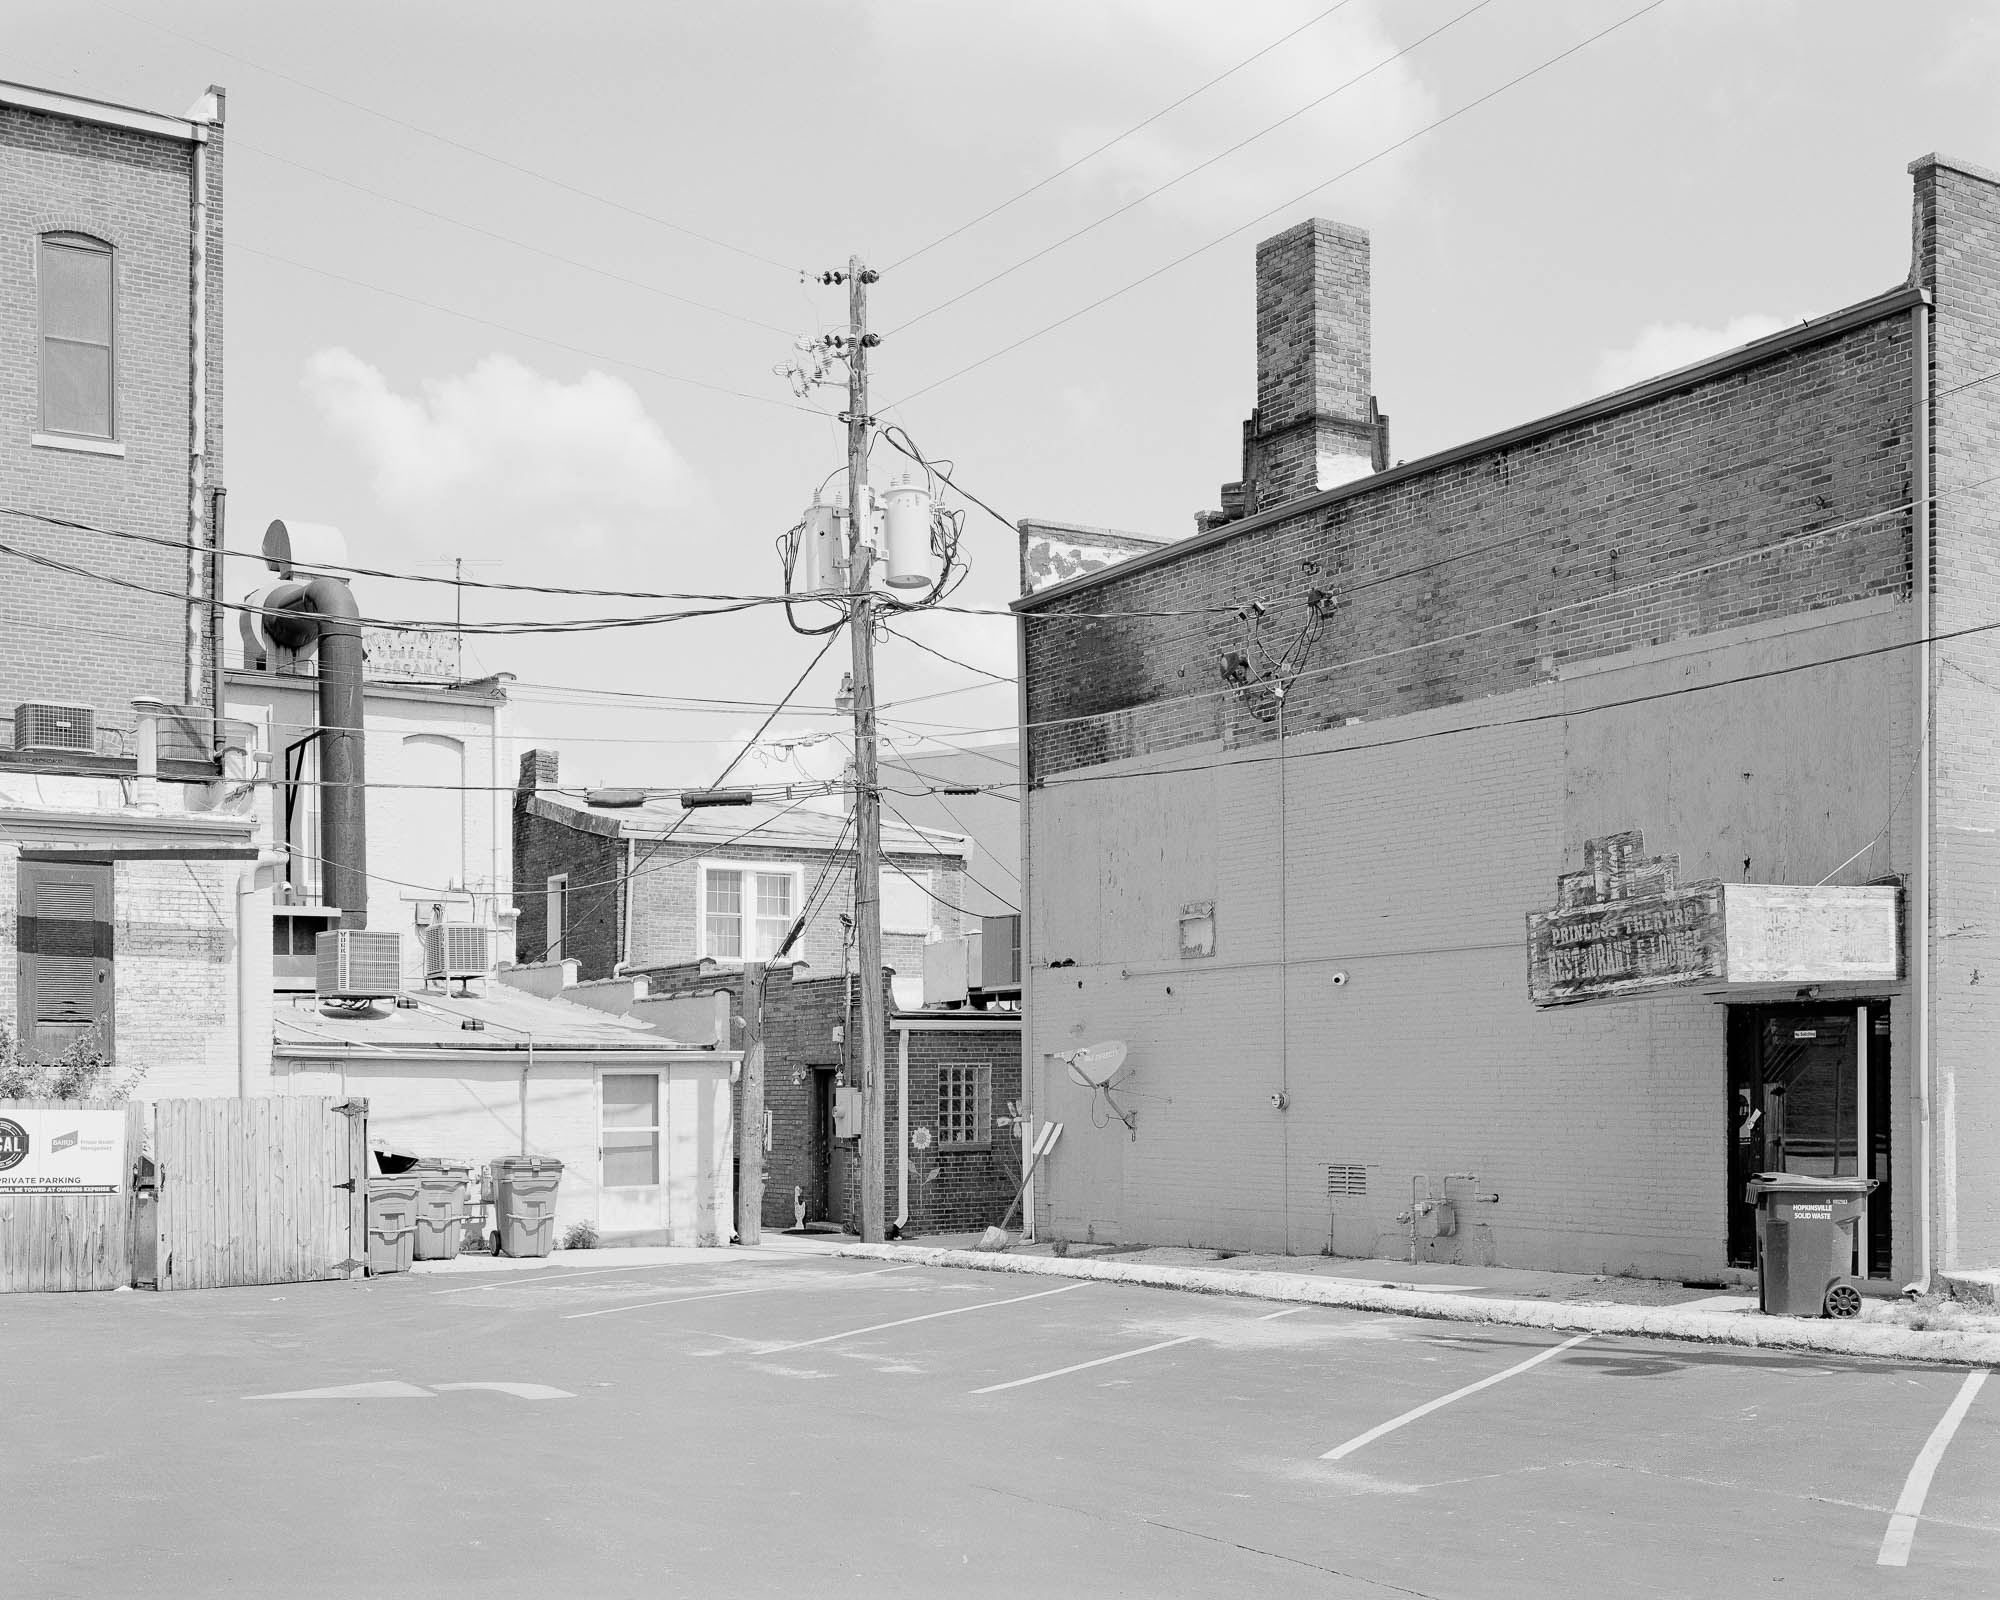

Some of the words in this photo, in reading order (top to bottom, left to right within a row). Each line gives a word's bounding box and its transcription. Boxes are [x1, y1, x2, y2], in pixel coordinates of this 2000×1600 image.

[1552, 920, 1618, 946] PRINCESS
[1623, 905, 1699, 933] THEATRE
[1549, 940, 1632, 983] RESTAURANT
